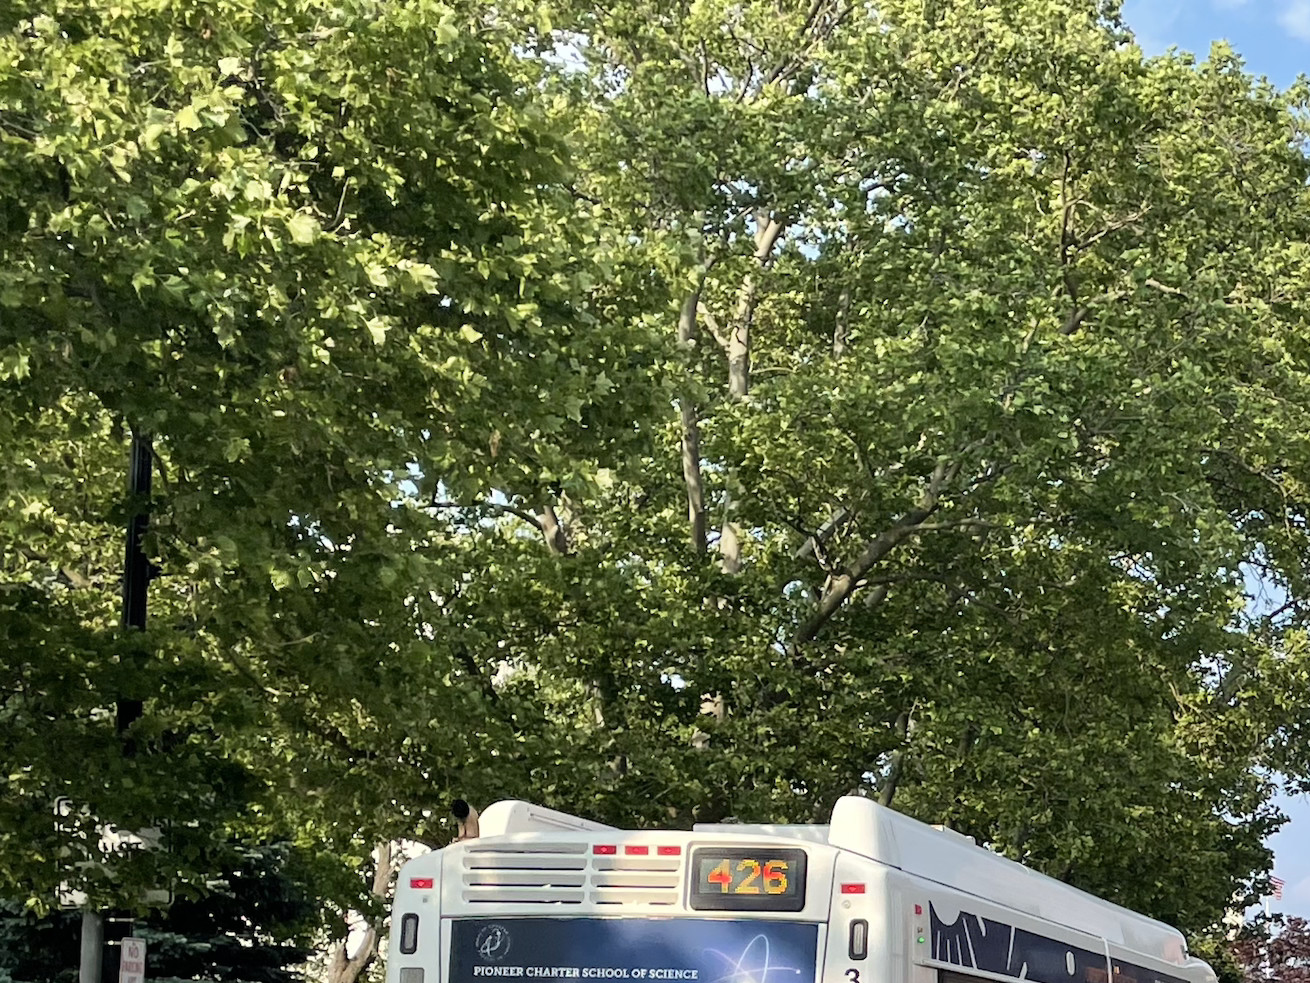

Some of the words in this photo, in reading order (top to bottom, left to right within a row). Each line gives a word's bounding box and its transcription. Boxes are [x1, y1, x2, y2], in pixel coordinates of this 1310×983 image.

[707, 858, 789, 895] 426
[128, 946, 139, 959] NO
[473, 966, 524, 977] PIONEER
[526, 967, 580, 978] CHARTER
[582, 968, 630, 979] SCHOOL
[631, 969, 647, 979] OF
[649, 969, 699, 980] SCIENCE
